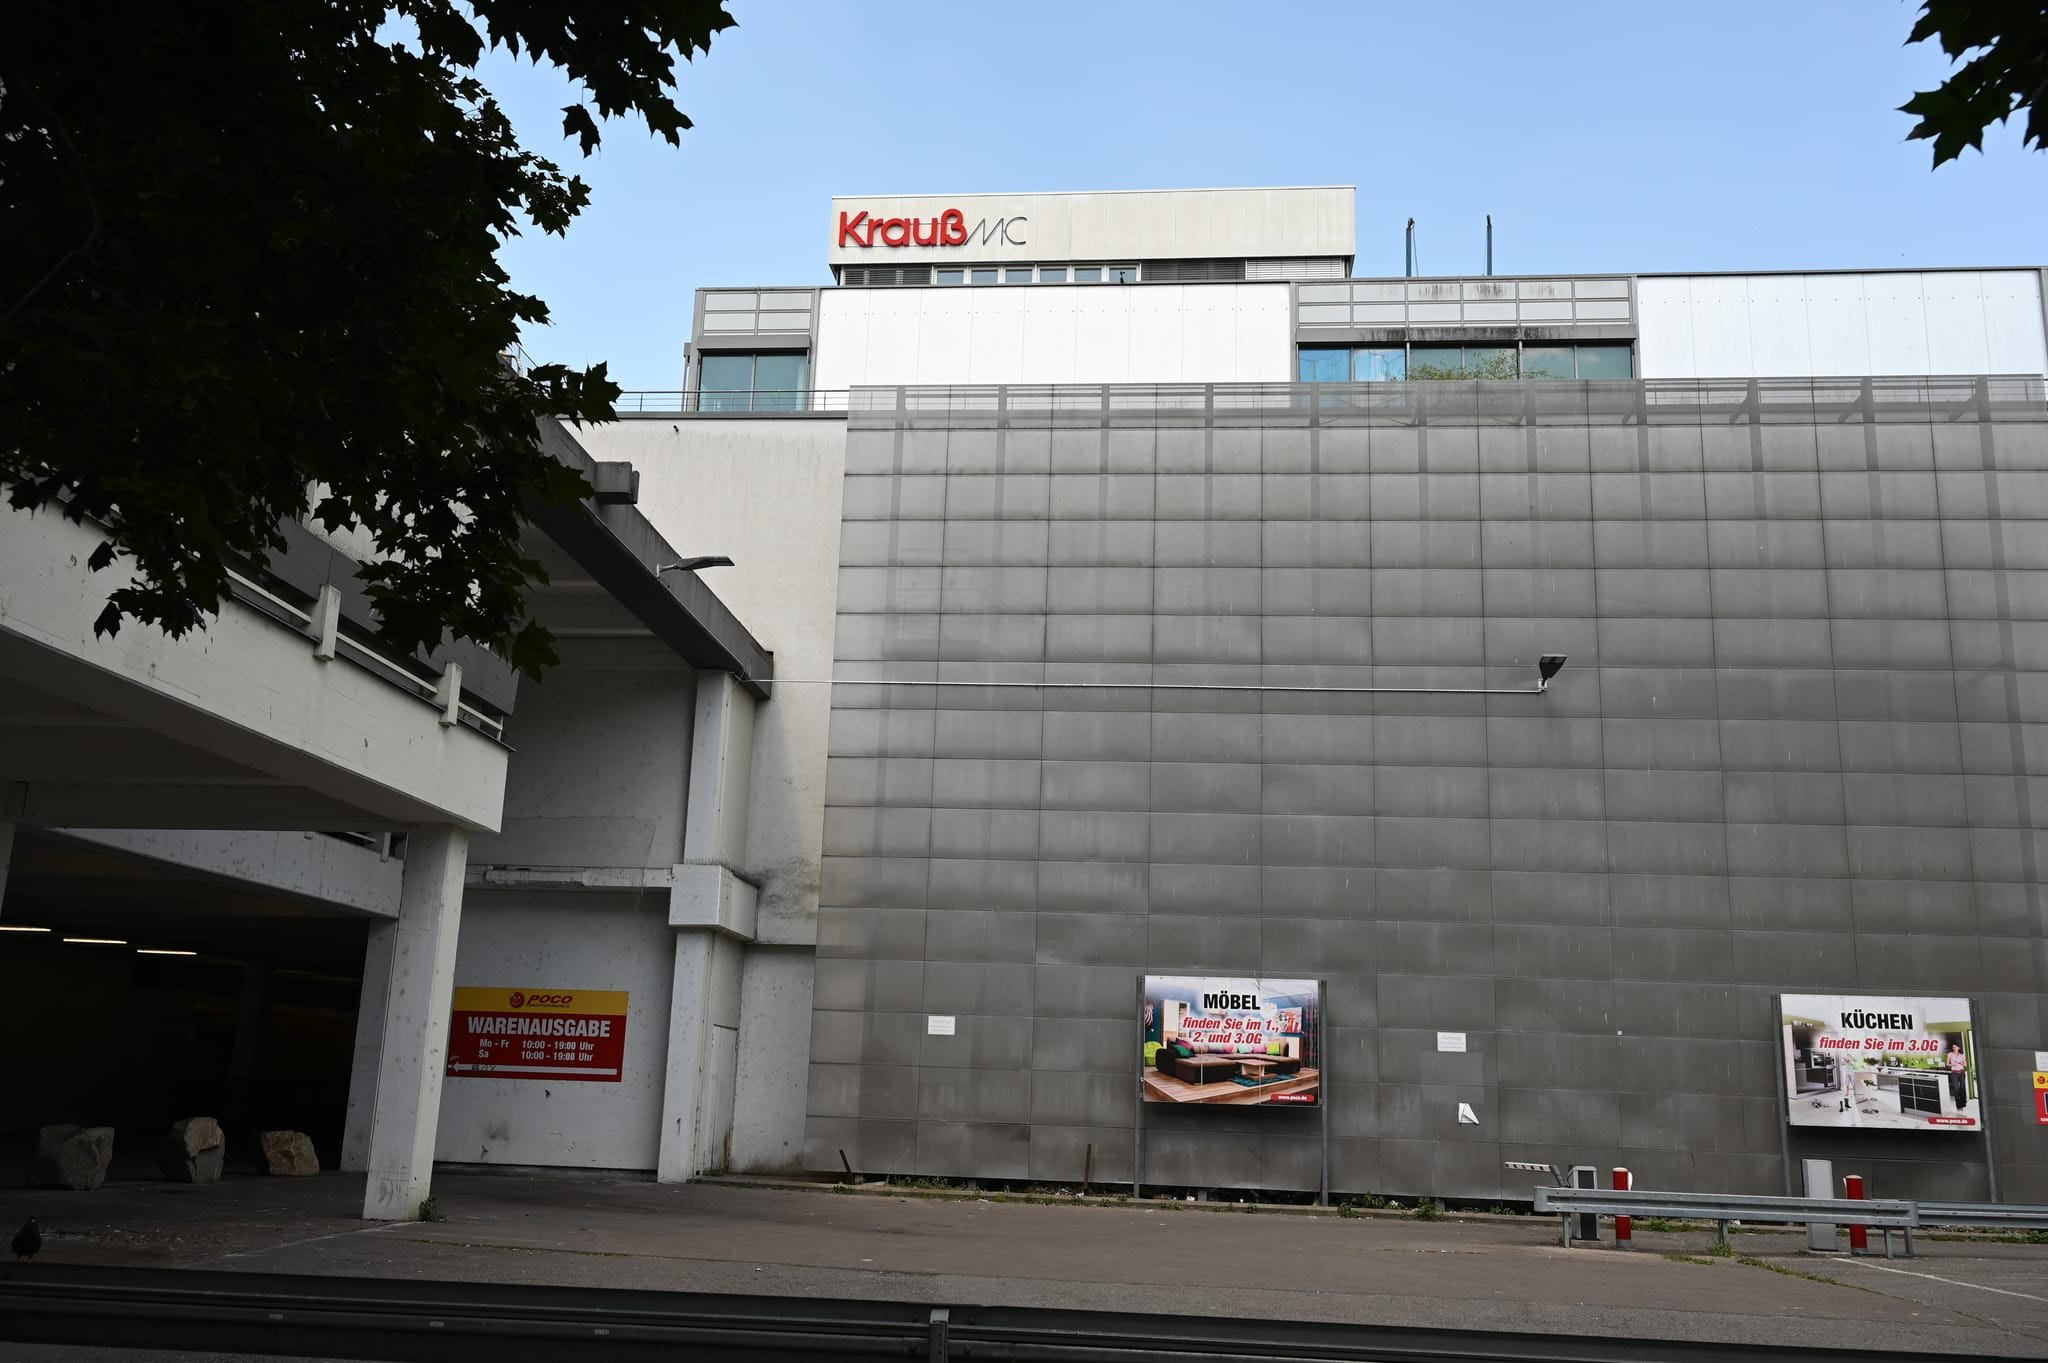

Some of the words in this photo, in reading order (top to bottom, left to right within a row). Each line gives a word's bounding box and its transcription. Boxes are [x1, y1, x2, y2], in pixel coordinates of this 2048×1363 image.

[527, 995, 573, 1004] POCO
[1203, 990, 1260, 1010] MÖBEL
[1182, 1016, 1220, 1029] finden
[1223, 1018, 1244, 1030] Sie
[1245, 1019, 1261, 1030] im
[1841, 1009, 1913, 1030] KÜCHEN
[468, 1016, 611, 1038] WARENAUSGABE
[1193, 1031, 1204, 1043] 2.
[1208, 1032, 1232, 1044] und
[1819, 1037, 1860, 1049] finden
[1864, 1038, 1885, 1050] Sie
[1887, 1039, 1904, 1050] im
[480, 1038, 492, 1048] Mo
[500, 1039, 510, 1048] Fr
[522, 1040, 545, 1049] 10:00
[554, 1041, 576, 1050] 19:00
[579, 1041, 595, 1051] Uhr
[478, 1049, 489, 1059] Sa
[521, 1051, 544, 1060] 10:00
[553, 1051, 575, 1061] 19:00
[578, 1053, 593, 1062] Uhr
